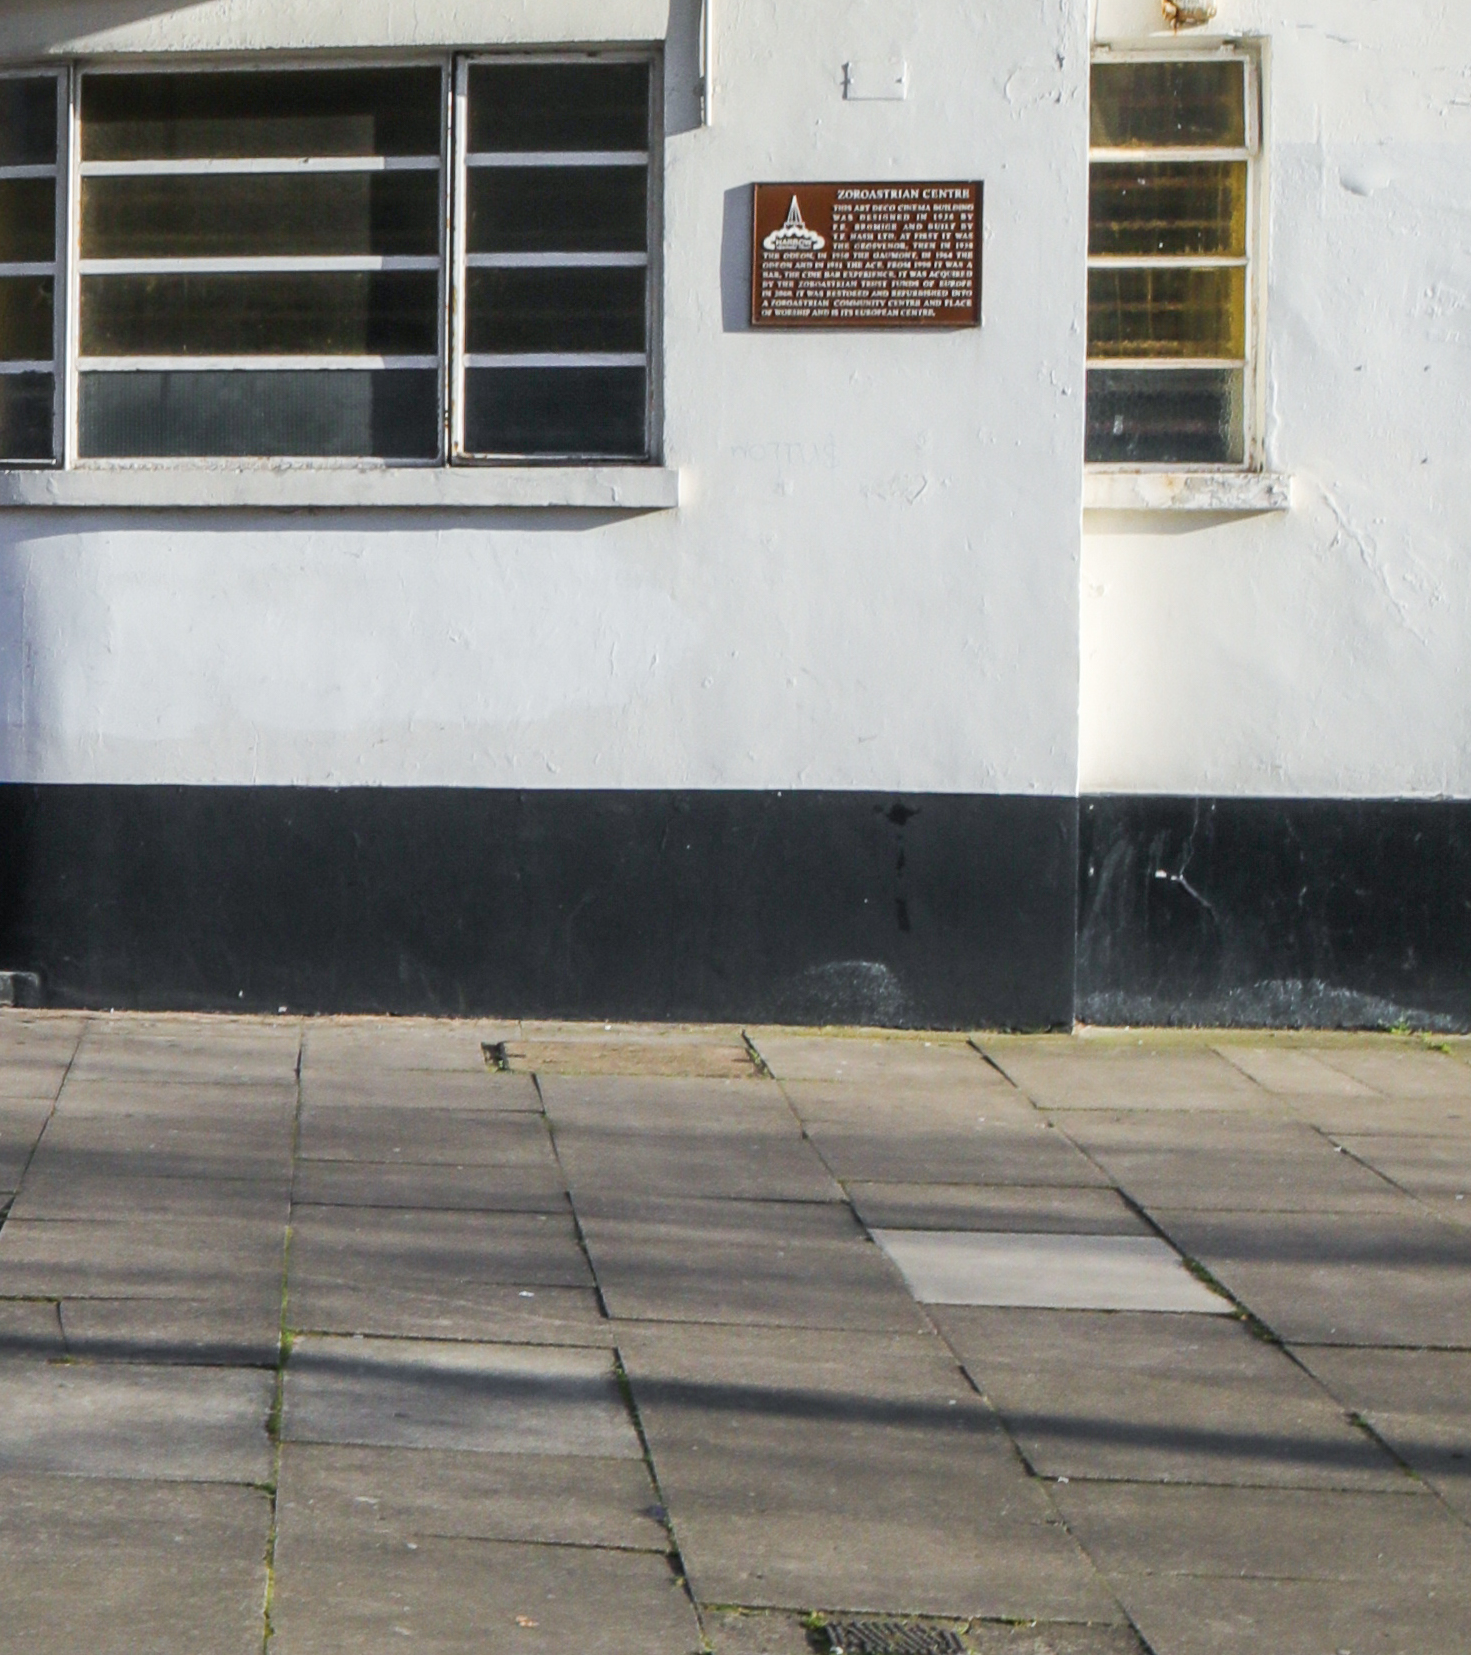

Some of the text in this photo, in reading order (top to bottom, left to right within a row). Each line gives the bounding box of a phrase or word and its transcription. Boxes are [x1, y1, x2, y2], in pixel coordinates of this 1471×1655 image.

[837, 189, 969, 199] ZOROASTRIAN CENTRE
[854, 204, 871, 212] ART
[872, 204, 895, 212] DECO
[898, 204, 931, 212] CINEMA
[933, 204, 974, 212] BUILDING
[903, 223, 923, 231] AND
[928, 223, 955, 231] BUILT
[961, 223, 973, 231] BY
[833, 242, 849, 250] THE
[913, 242, 936, 250] THEN
[940, 242, 951, 250] IN
[763, 252, 779, 260] THE
[817, 252, 827, 260] IN
[853, 252, 869, 260] THE
[921, 252, 931, 260] IN
[956, 252, 973, 260] THE
[763, 261, 793, 269] ODEON
[795, 261, 812, 269] AND
[815, 261, 824, 269] IN
[847, 261, 863, 269] THE
[887, 261, 911, 269] FROM
[934, 261, 942, 269] IT
[945, 261, 963, 269] WAS
[967, 261, 972, 269] A
[784, 271, 800, 279] THE
[824, 271, 840, 279] BAR
[898, 271, 907, 279] IT
[909, 271, 927, 279] WAS
[929, 271, 973, 279] ACQUIRED
[762, 280, 972, 288] BY THE ZOROASTRIAN TRUST FUNDS OF EUROPE
[762, 299, 972, 307] A ZOROASTRIAN COMMUNITY CENTRE AND PLACE
